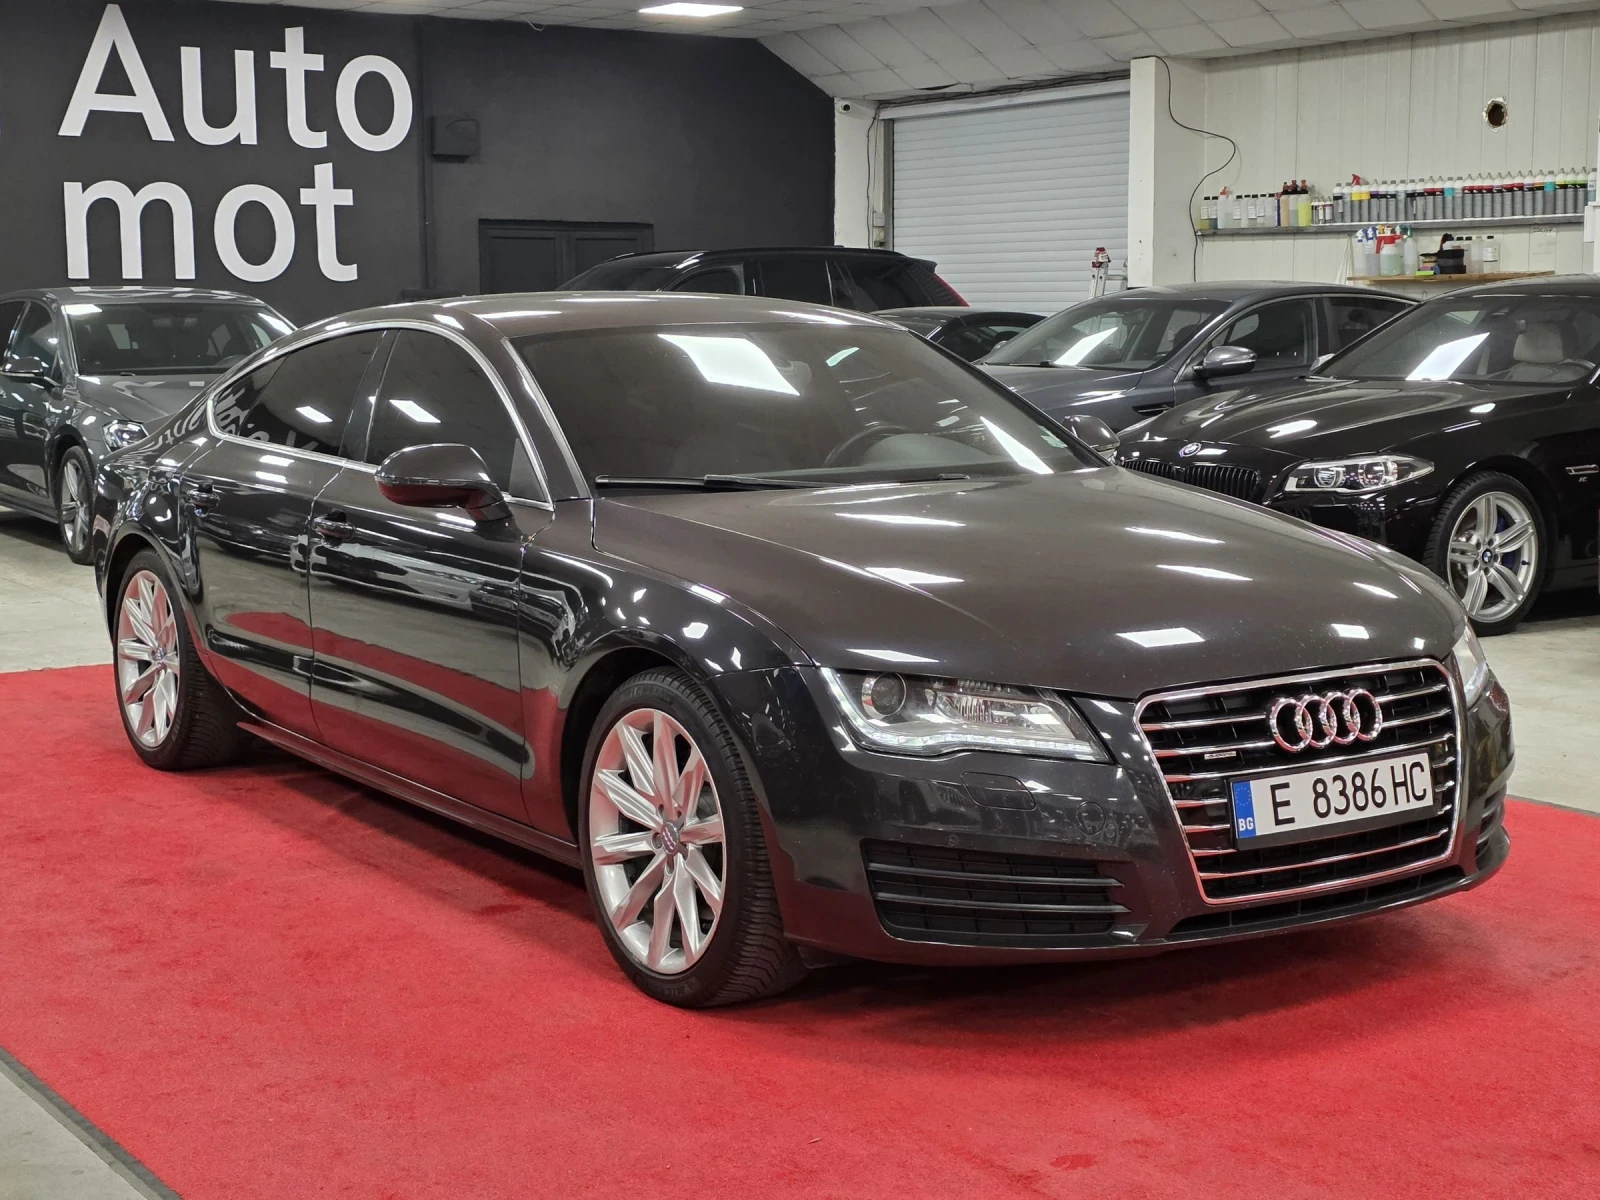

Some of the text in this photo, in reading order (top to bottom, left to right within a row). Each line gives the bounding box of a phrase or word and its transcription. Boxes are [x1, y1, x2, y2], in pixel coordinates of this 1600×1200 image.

[58, 3, 413, 152] Auto
[63, 162, 358, 282] mot
[1238, 817, 1254, 832] BG
[1270, 761, 1427, 826] E 8386 HC
